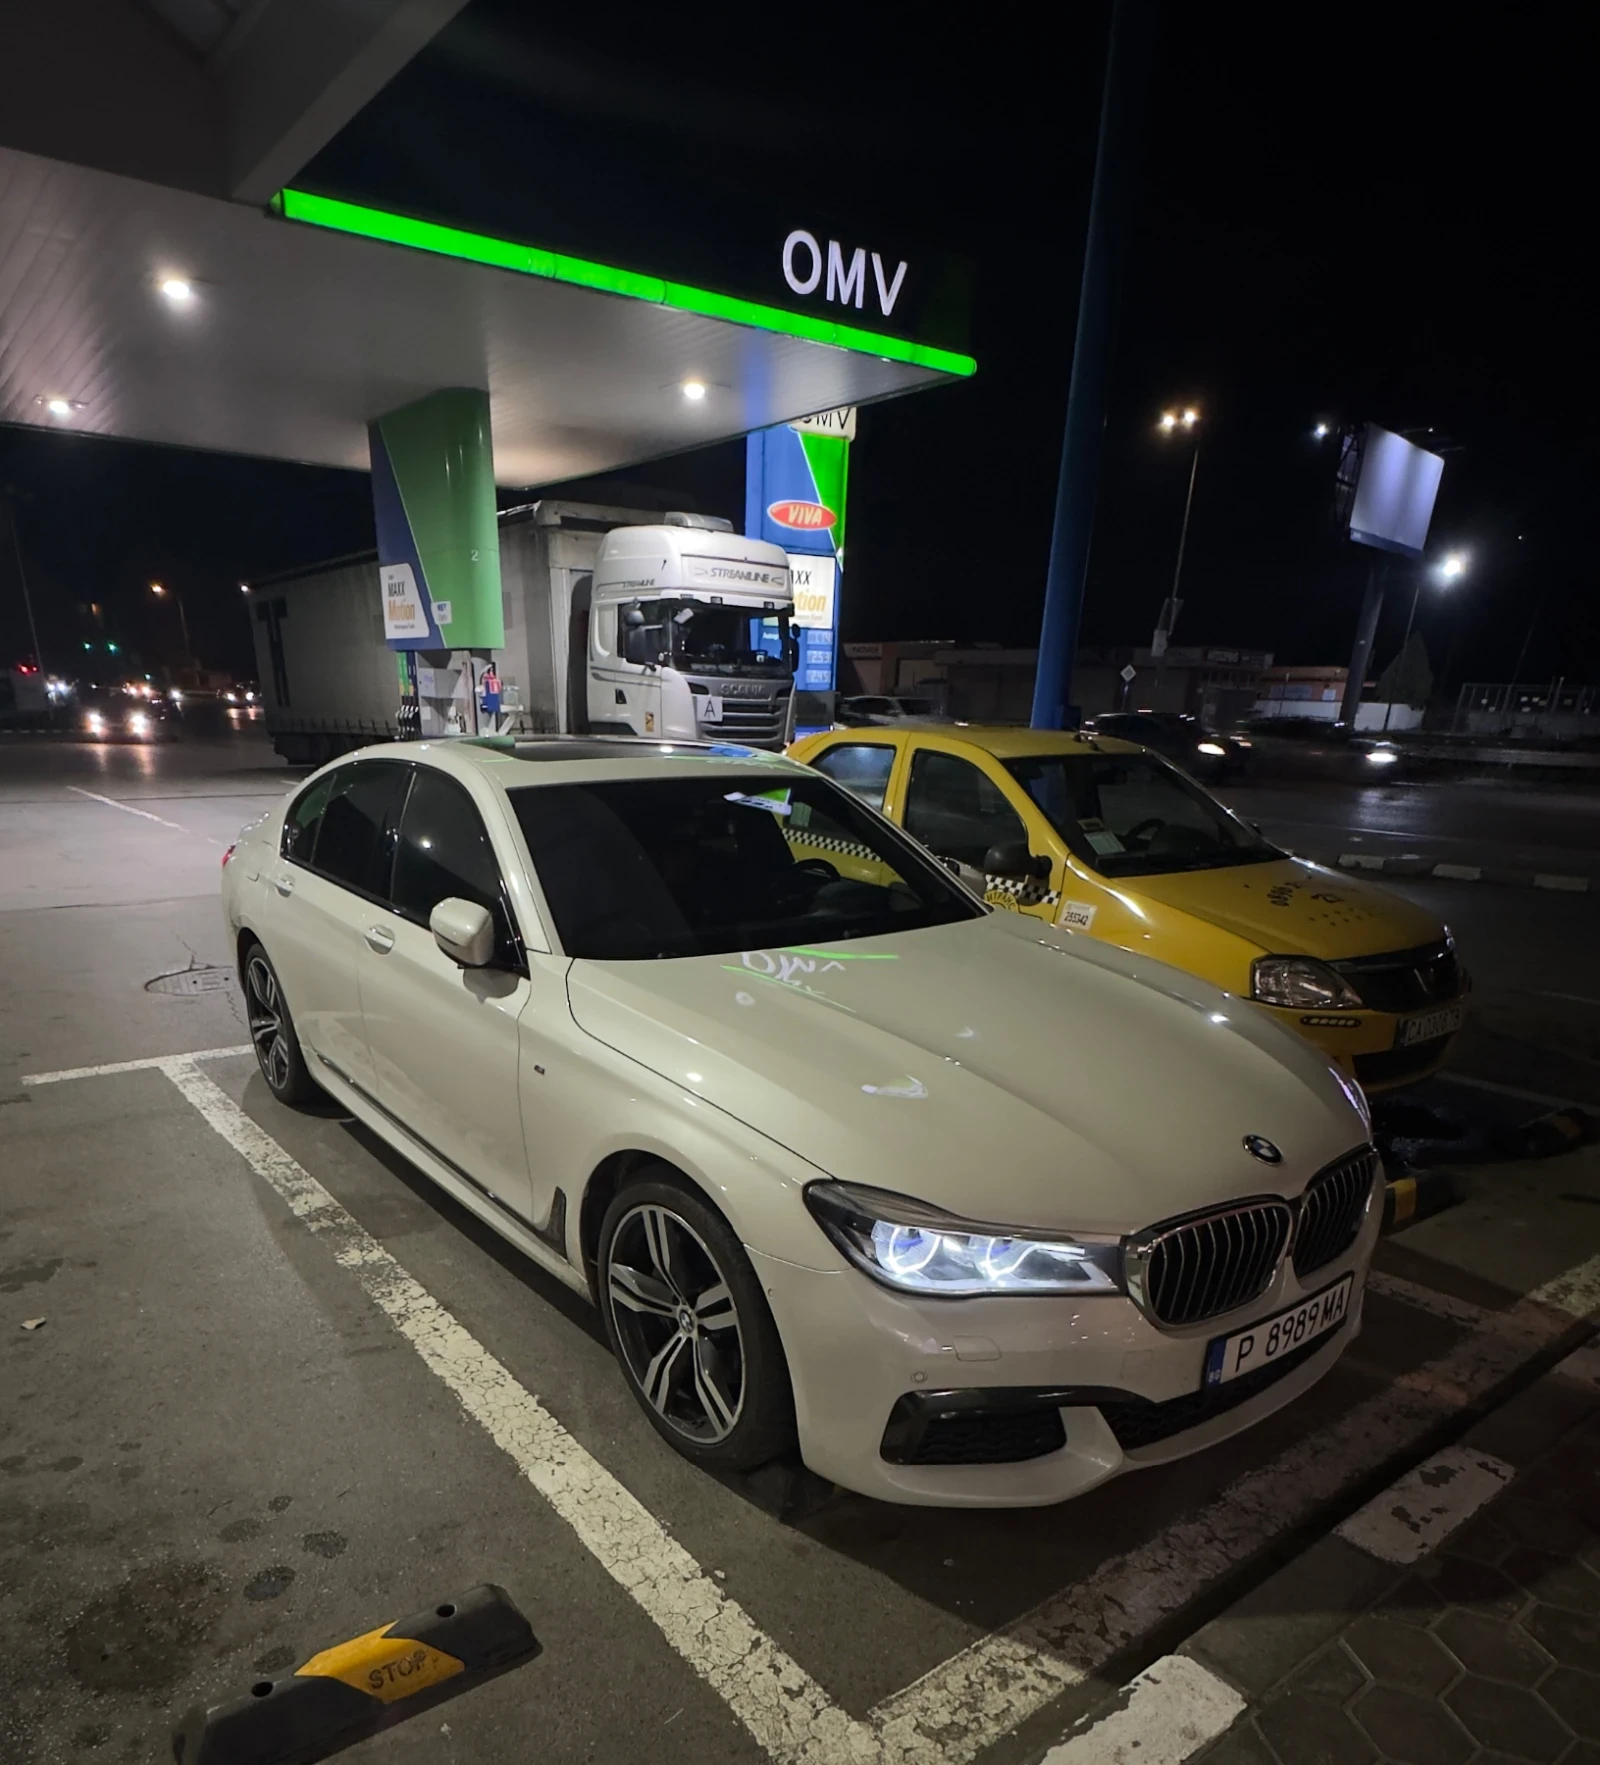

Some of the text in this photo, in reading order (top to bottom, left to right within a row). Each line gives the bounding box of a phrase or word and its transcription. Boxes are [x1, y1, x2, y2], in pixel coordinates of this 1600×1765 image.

[782, 229, 908, 317] OMV
[788, 504, 823, 528] VIVA
[471, 550, 479, 562] 2
[710, 566, 770, 583] STREAMLINE
[790, 569, 812, 586] XX
[388, 580, 405, 597] MAXX
[388, 600, 416, 621] Motion
[794, 590, 827, 613] tion
[704, 699, 716, 718] A
[1063, 911, 1089, 927] 255342
[1236, 1286, 1347, 1372] P 8989 MA
[370, 1651, 427, 1689] STOP
